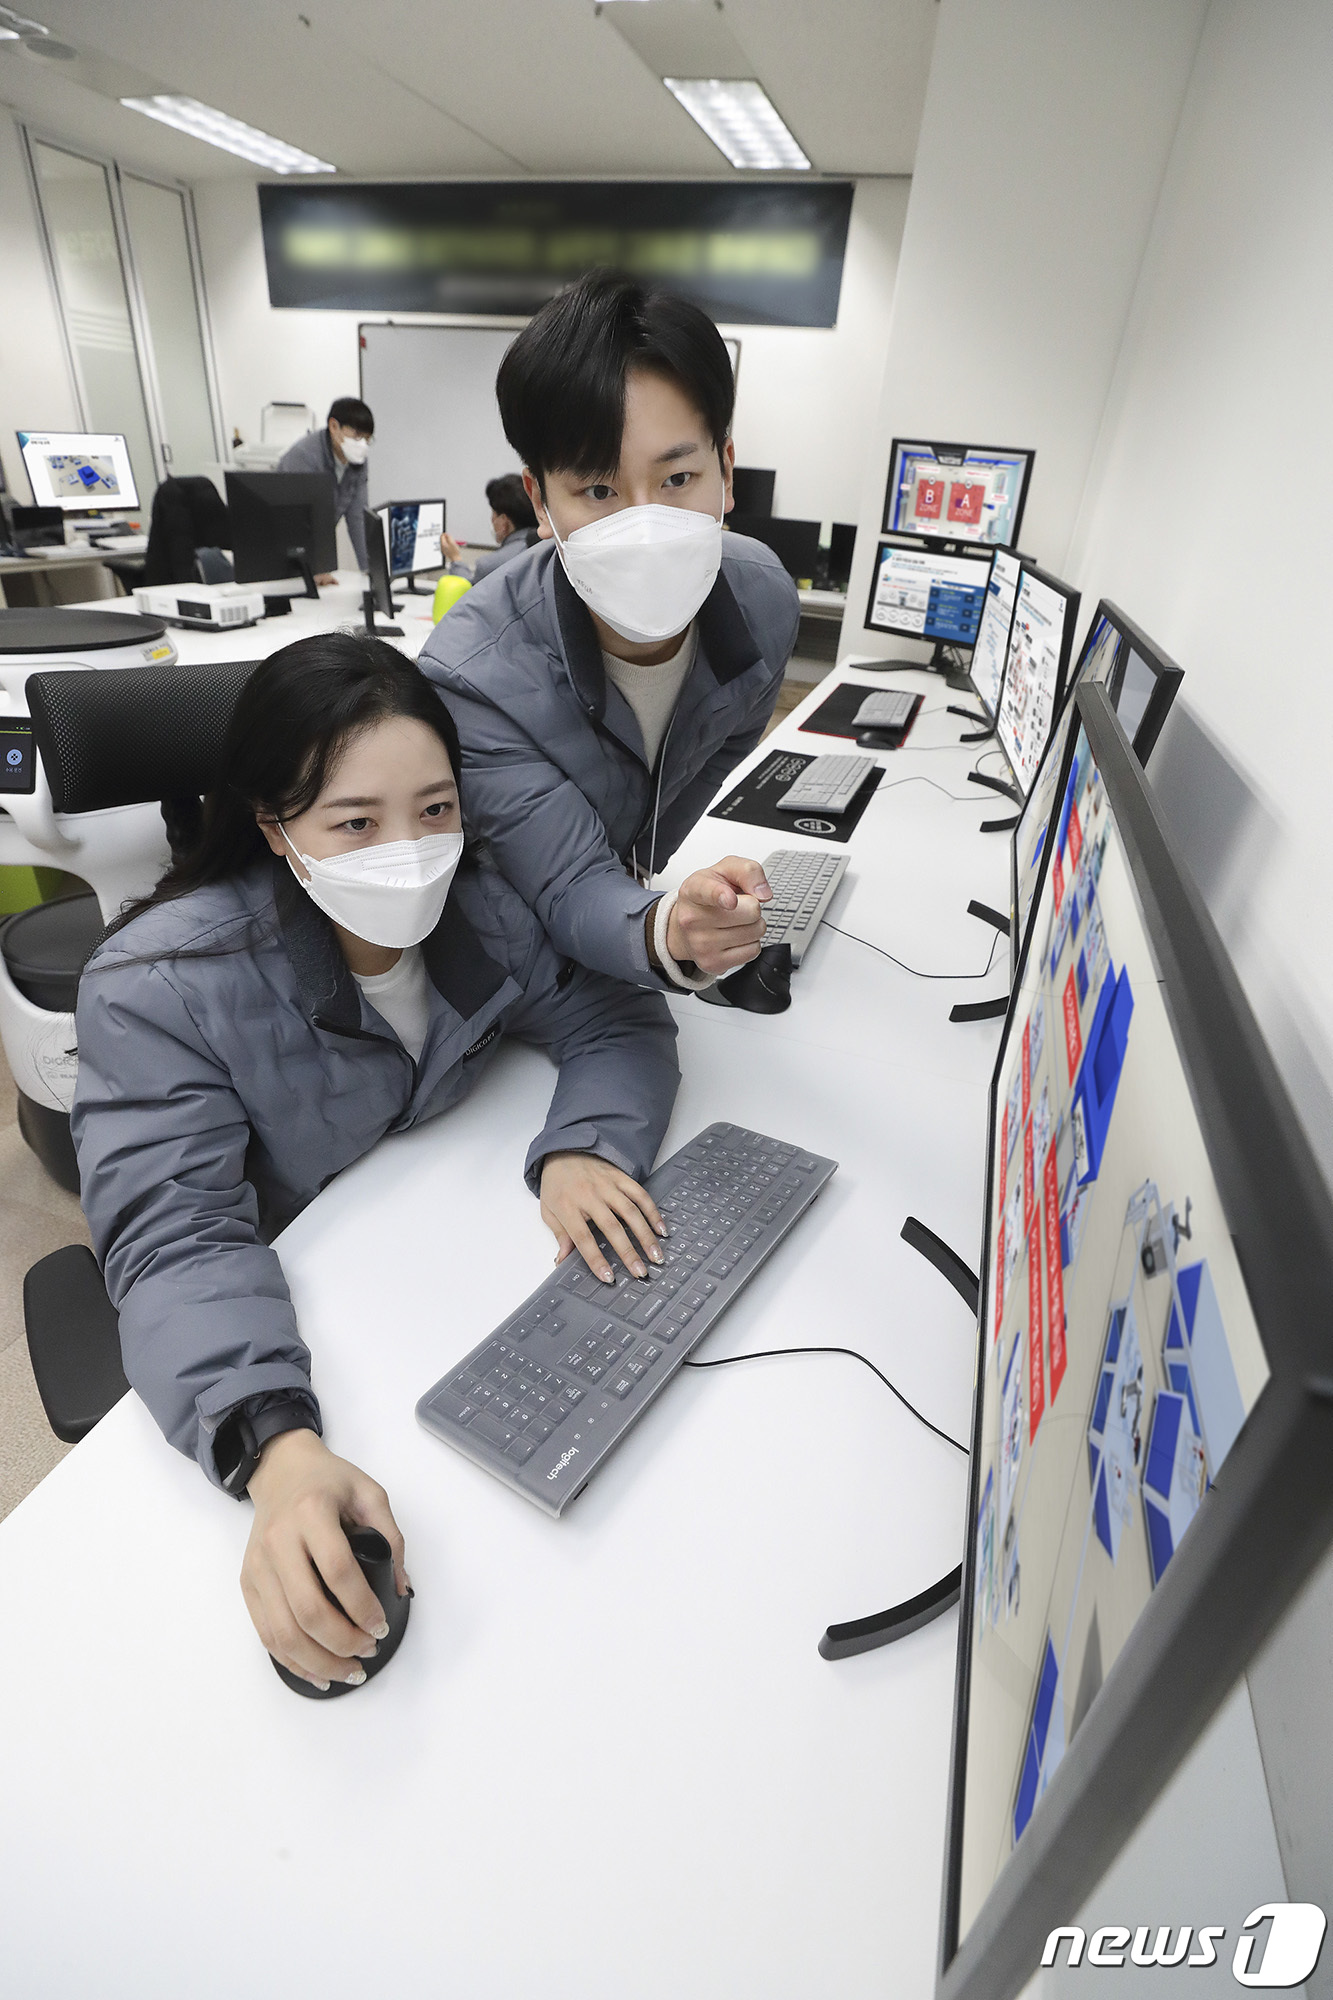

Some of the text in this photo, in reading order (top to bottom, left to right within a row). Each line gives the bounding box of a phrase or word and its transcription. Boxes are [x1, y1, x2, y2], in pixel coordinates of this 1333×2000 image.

[925, 489, 935, 503] B
[960, 494, 970, 508] A
[919, 503, 939, 513] ZONE
[955, 509, 974, 518] ZONE
[43, 1055, 79, 1066] DIGIC
[458, 1406, 471, 1418] Enter
[547, 1447, 579, 1480] logitech
